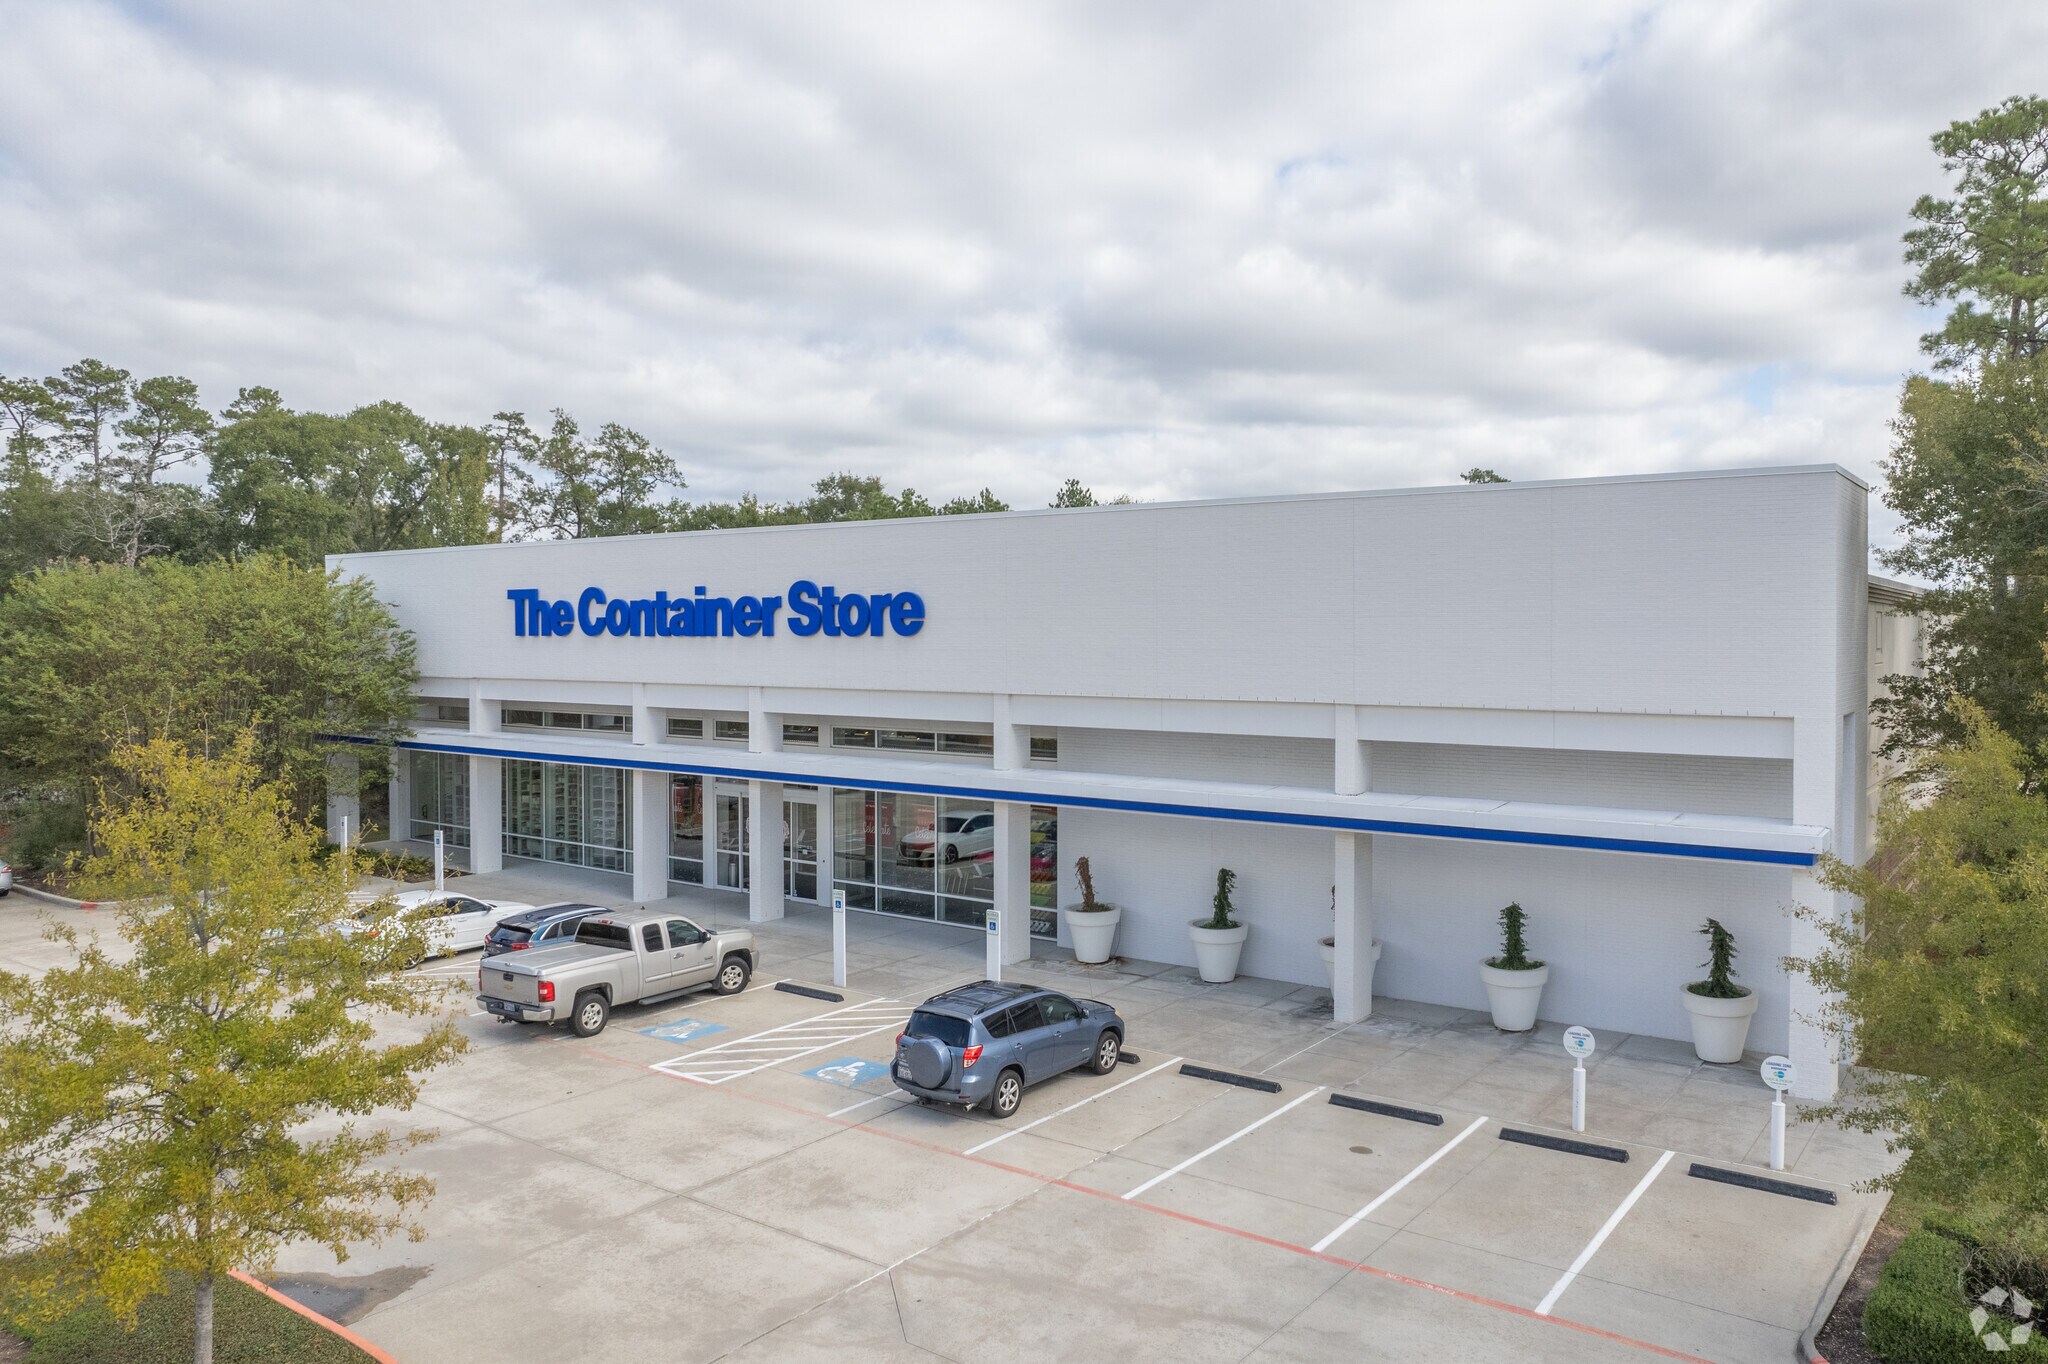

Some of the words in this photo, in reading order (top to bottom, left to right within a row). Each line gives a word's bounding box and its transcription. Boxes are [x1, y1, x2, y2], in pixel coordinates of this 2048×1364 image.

[507, 588, 575, 637] The
[578, 585, 783, 638] Container
[788, 580, 926, 638] Store
[863, 821, 891, 836] Celeate
